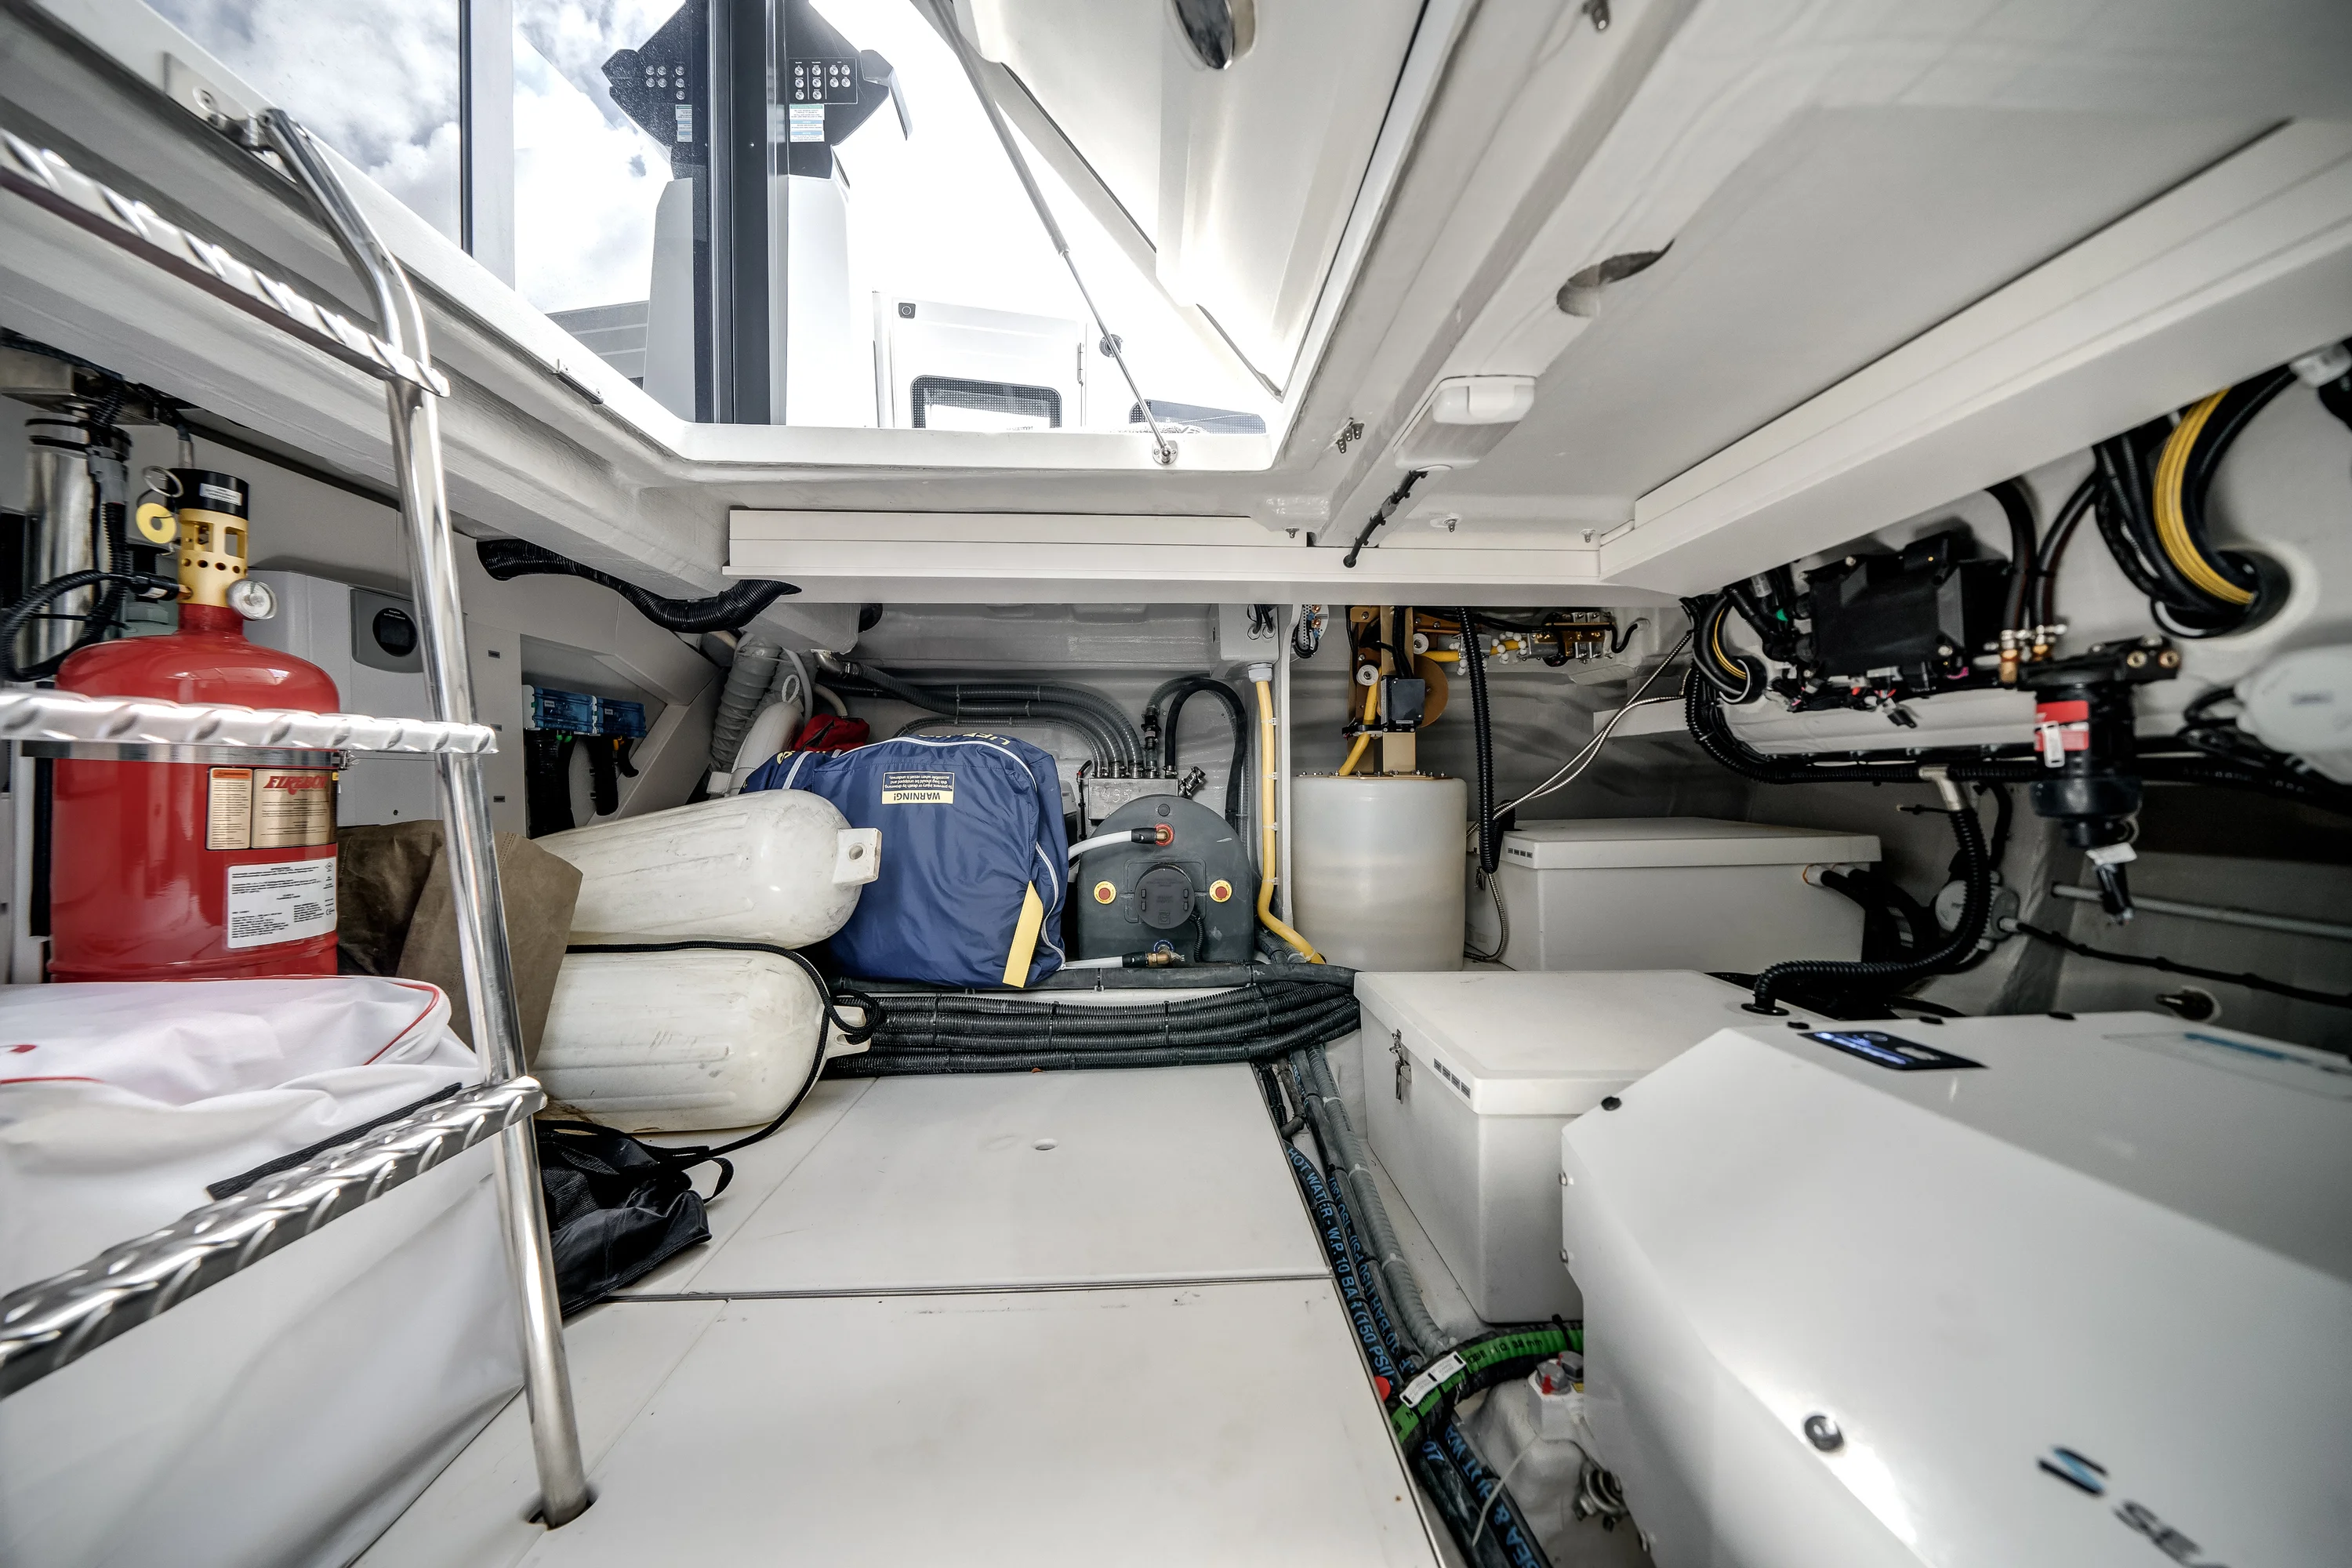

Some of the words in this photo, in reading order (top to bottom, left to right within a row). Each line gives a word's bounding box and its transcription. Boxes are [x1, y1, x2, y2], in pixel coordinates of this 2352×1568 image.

[894, 792, 940, 801] WARNING!
[1287, 1148, 1312, 1172] HOT
[1306, 1171, 1333, 1218] WATER
[1327, 1227, 1345, 1254] W.P.
[1336, 1256, 1350, 1273] 10
[1341, 1276, 1363, 1310] BAR
[1353, 1311, 1377, 1343] (150
[1370, 1298, 1391, 1333] BAR
[1369, 1346, 1395, 1377] PSI)
